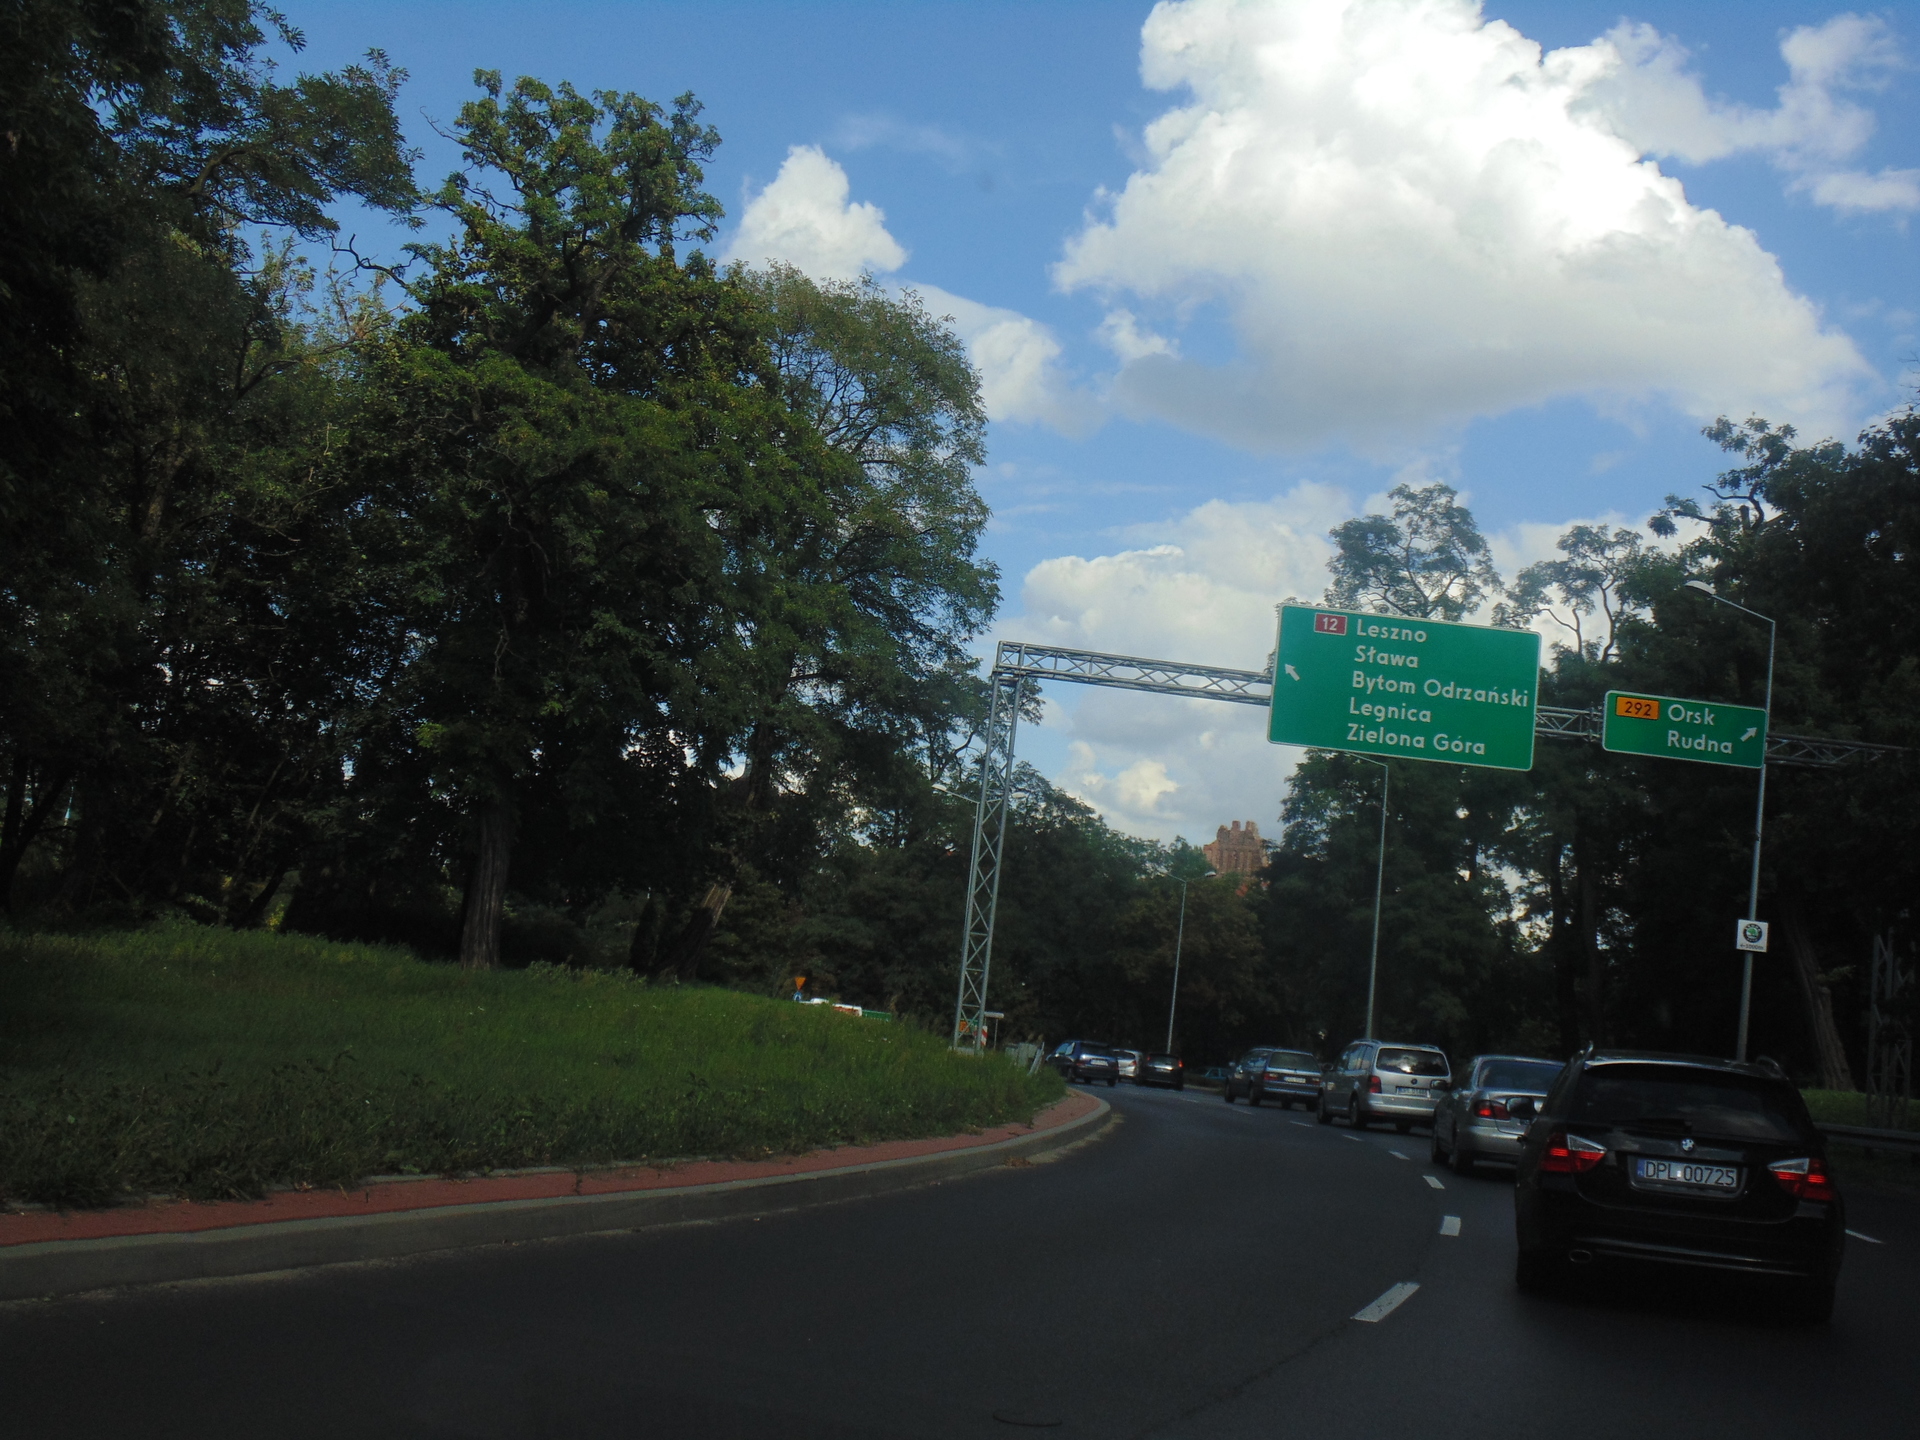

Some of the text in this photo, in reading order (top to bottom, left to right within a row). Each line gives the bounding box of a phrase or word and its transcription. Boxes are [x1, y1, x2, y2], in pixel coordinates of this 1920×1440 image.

[1322, 617, 1338, 631] 12
[1357, 619, 1427, 643] Leszno
[1354, 645, 1419, 668] Sława
[1352, 671, 1529, 707] Bytom Odrzański
[1350, 697, 1431, 723] Legnica
[1624, 701, 1652, 717] 292
[1668, 704, 1715, 726] Orsk
[1347, 723, 1486, 756] Zielona Góra
[1667, 730, 1733, 754] Rudna
[1645, 1161, 1735, 1186] DPL 00725
